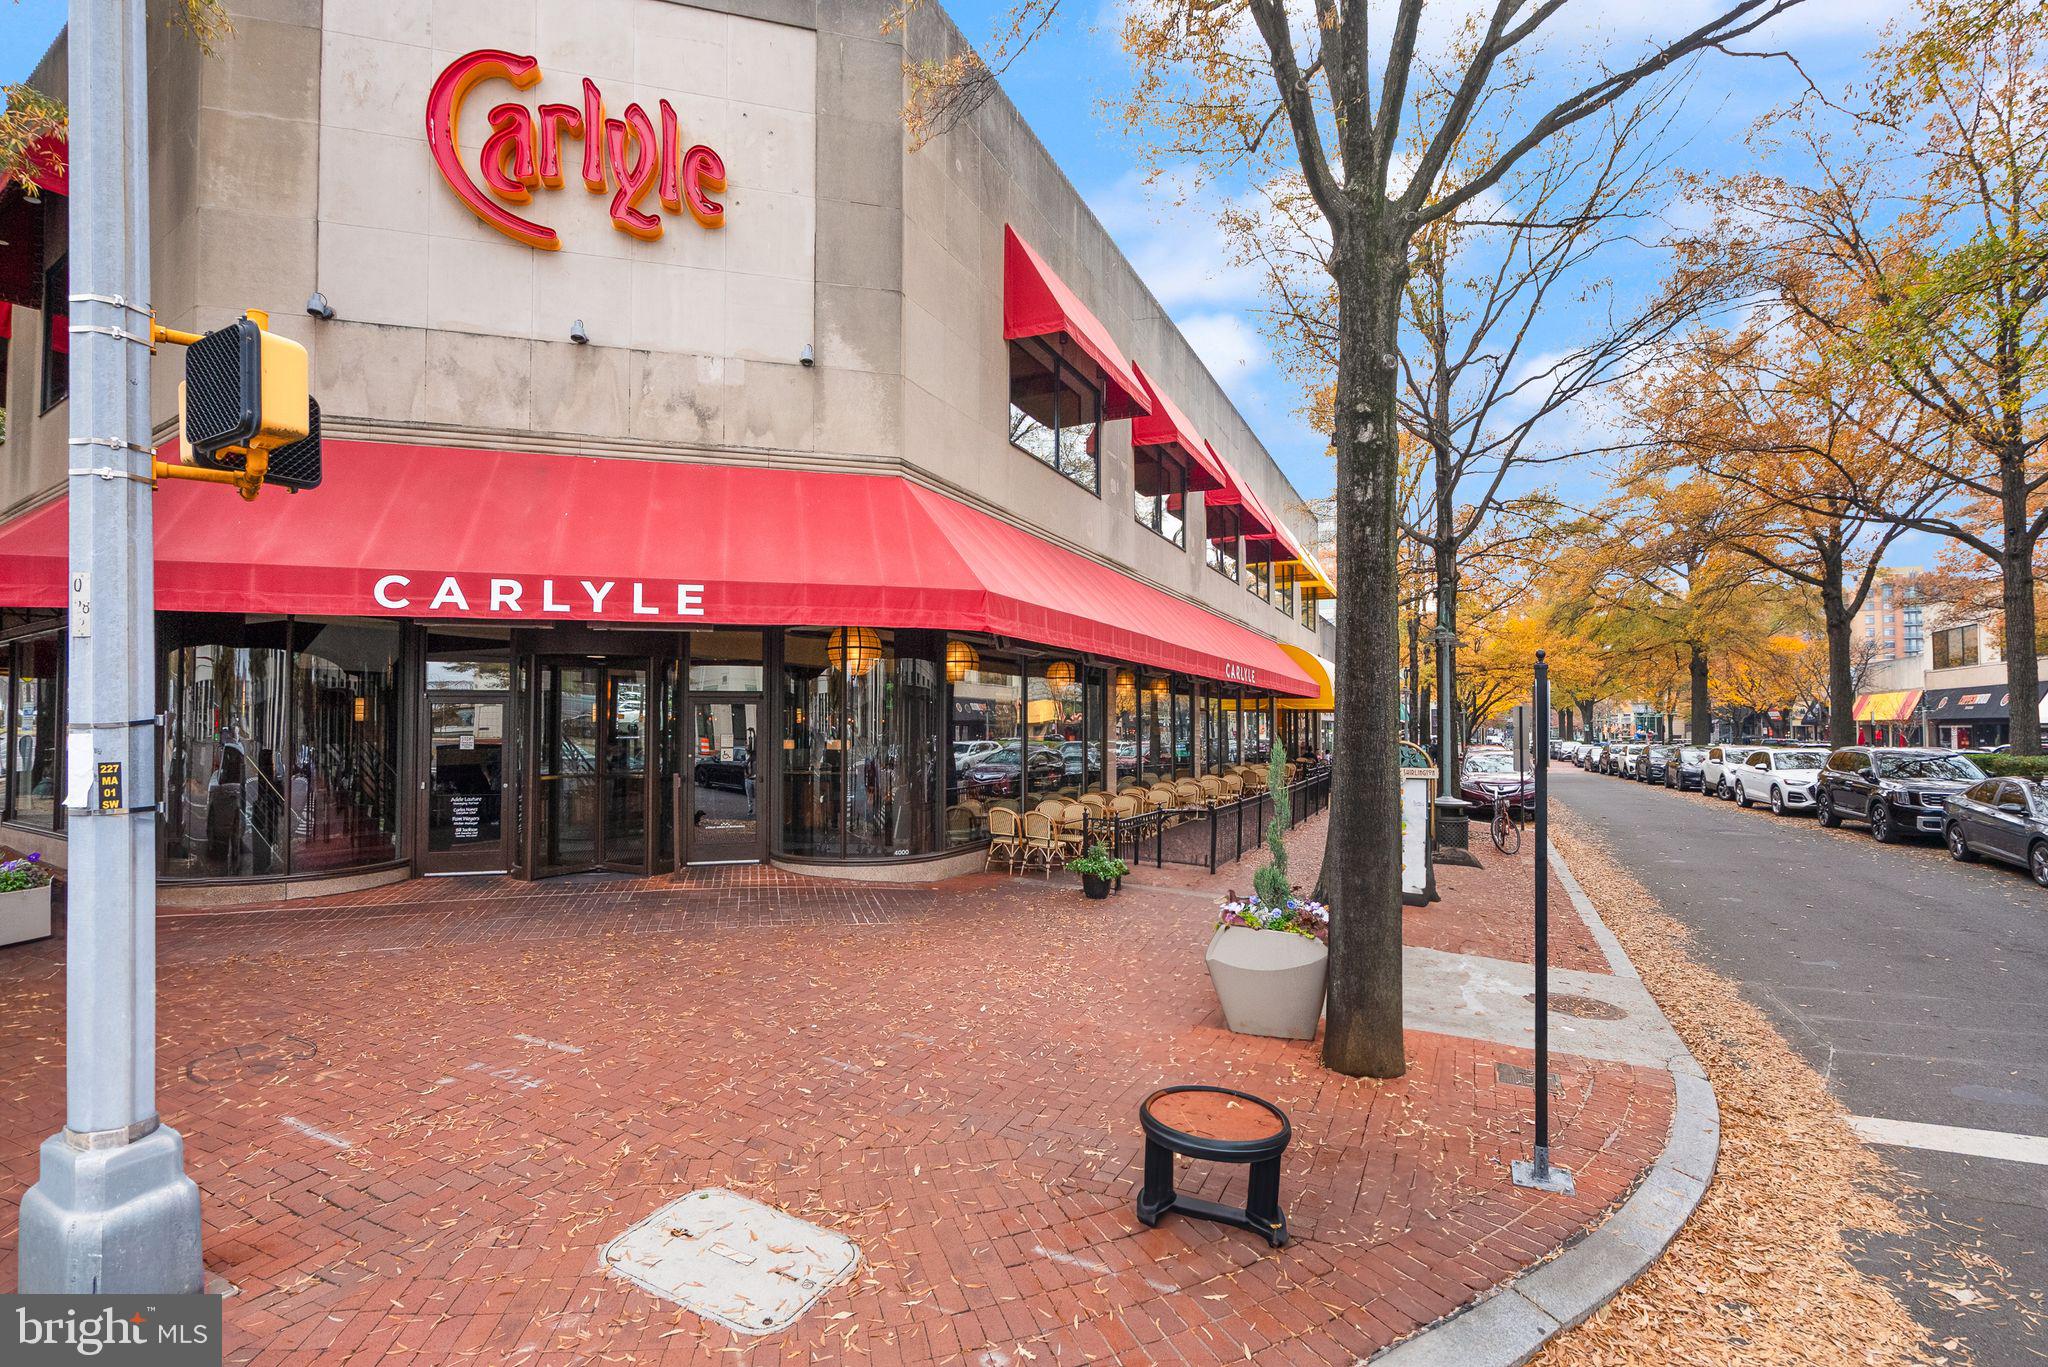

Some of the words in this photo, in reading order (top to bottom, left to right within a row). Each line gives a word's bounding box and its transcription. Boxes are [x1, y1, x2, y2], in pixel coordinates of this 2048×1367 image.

[426, 49, 728, 251] Carlyle
[373, 574, 706, 616] CARLYLE
[1226, 663, 1255, 683] CARLYLE
[100, 764, 119, 773] 227
[102, 776, 118, 785] MA
[103, 788, 116, 797] 01
[102, 800, 119, 809] SW
